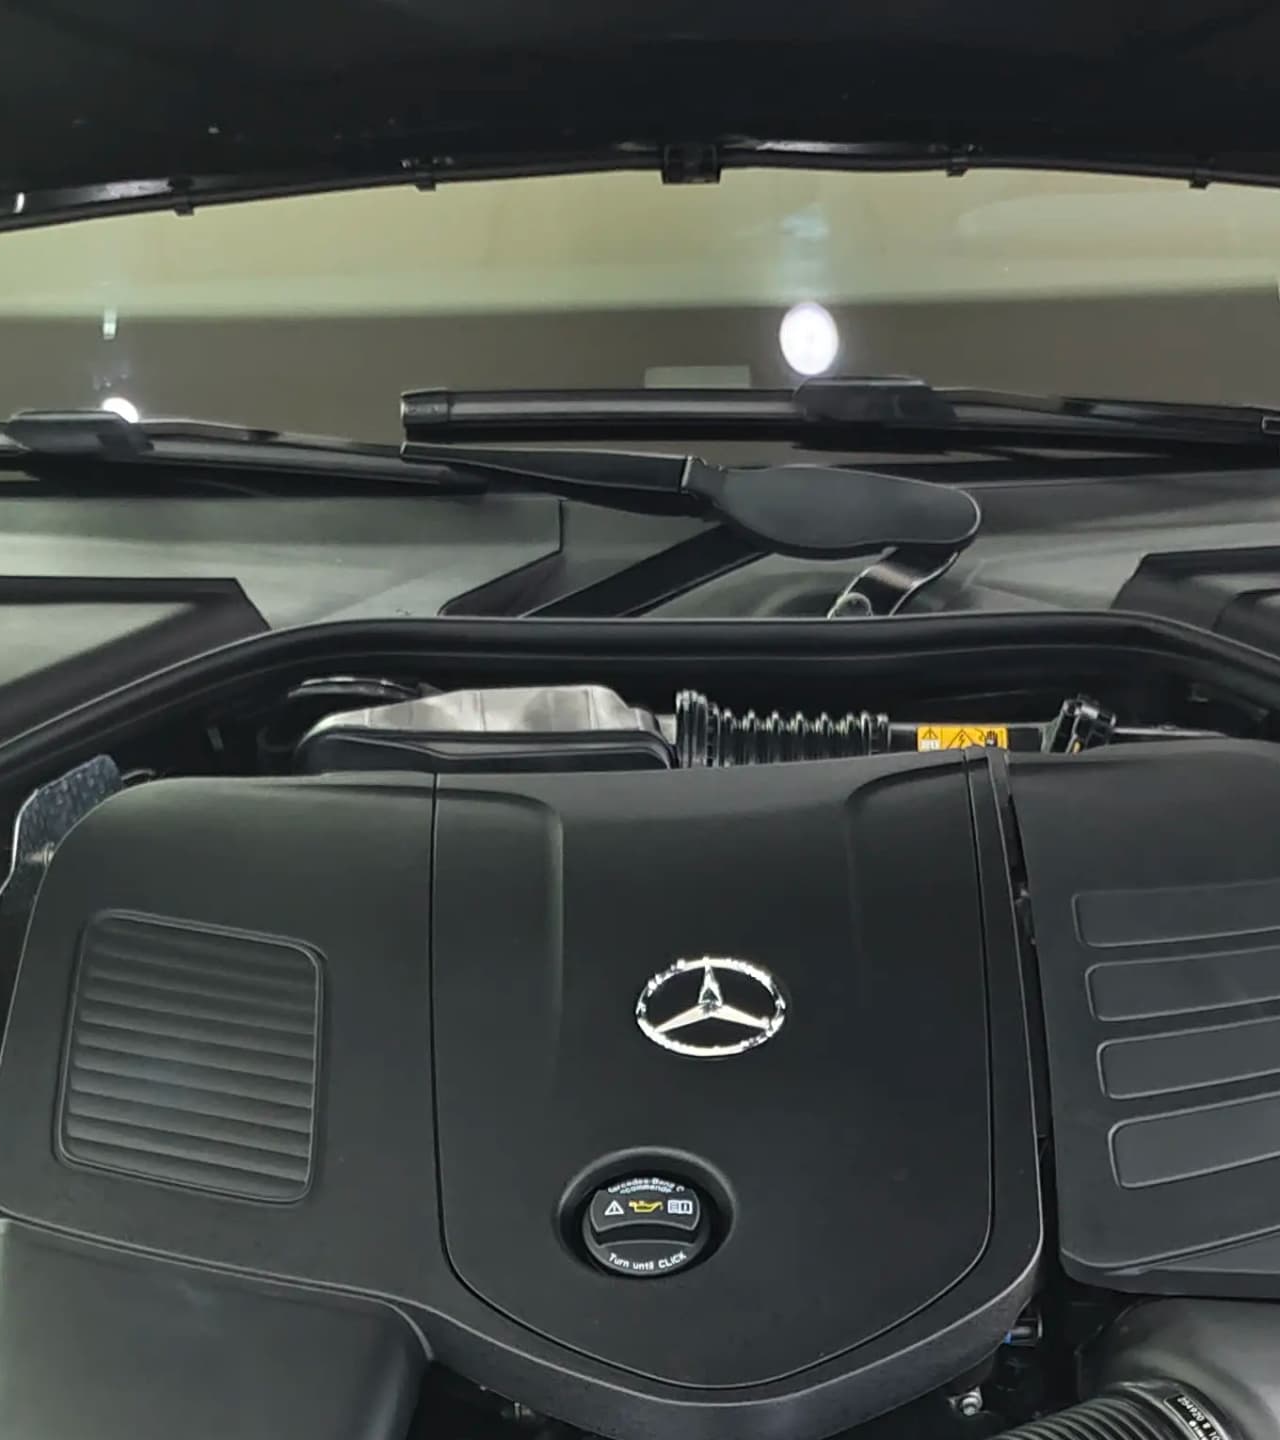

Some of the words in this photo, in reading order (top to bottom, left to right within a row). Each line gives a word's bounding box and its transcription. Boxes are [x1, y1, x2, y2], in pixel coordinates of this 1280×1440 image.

[609, 1253, 629, 1268] Turn
[632, 1261, 654, 1270] until
[658, 1251, 687, 1268] CLICK
